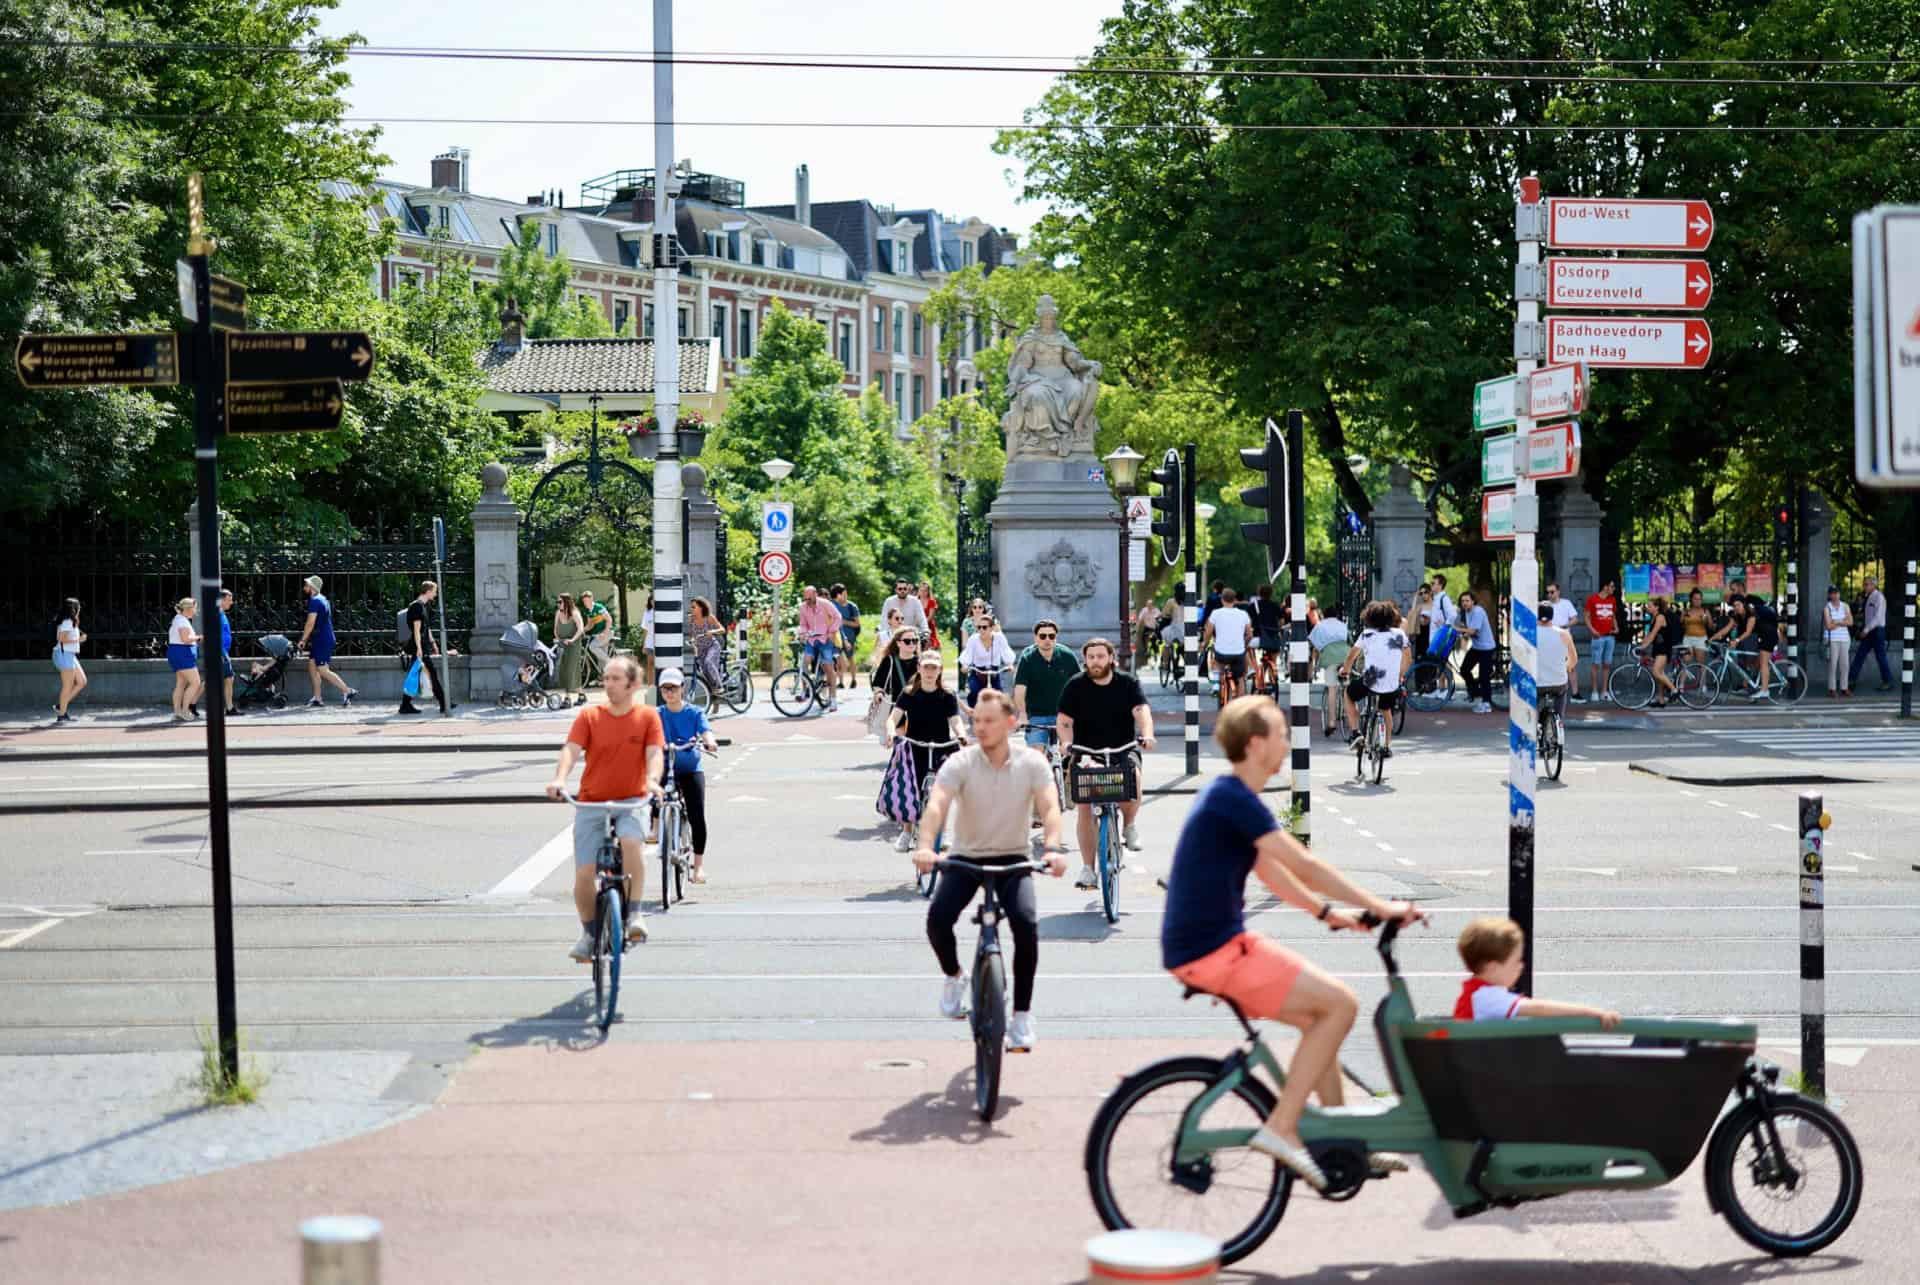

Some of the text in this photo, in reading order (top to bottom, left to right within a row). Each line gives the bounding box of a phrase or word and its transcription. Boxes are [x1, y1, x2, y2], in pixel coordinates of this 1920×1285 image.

[1557, 206, 1631, 219] Oud-West
[1557, 265, 1610, 281] Osdorp
[1556, 285, 1643, 299] Geuzenveld
[1556, 324, 1663, 340] Badhoevedorp
[42, 343, 113, 354] Rijksmuseum
[1556, 344, 1627, 360] Den Haag
[43, 355, 115, 367] Museumplein
[44, 368, 142, 380] Van Gogh Museum
